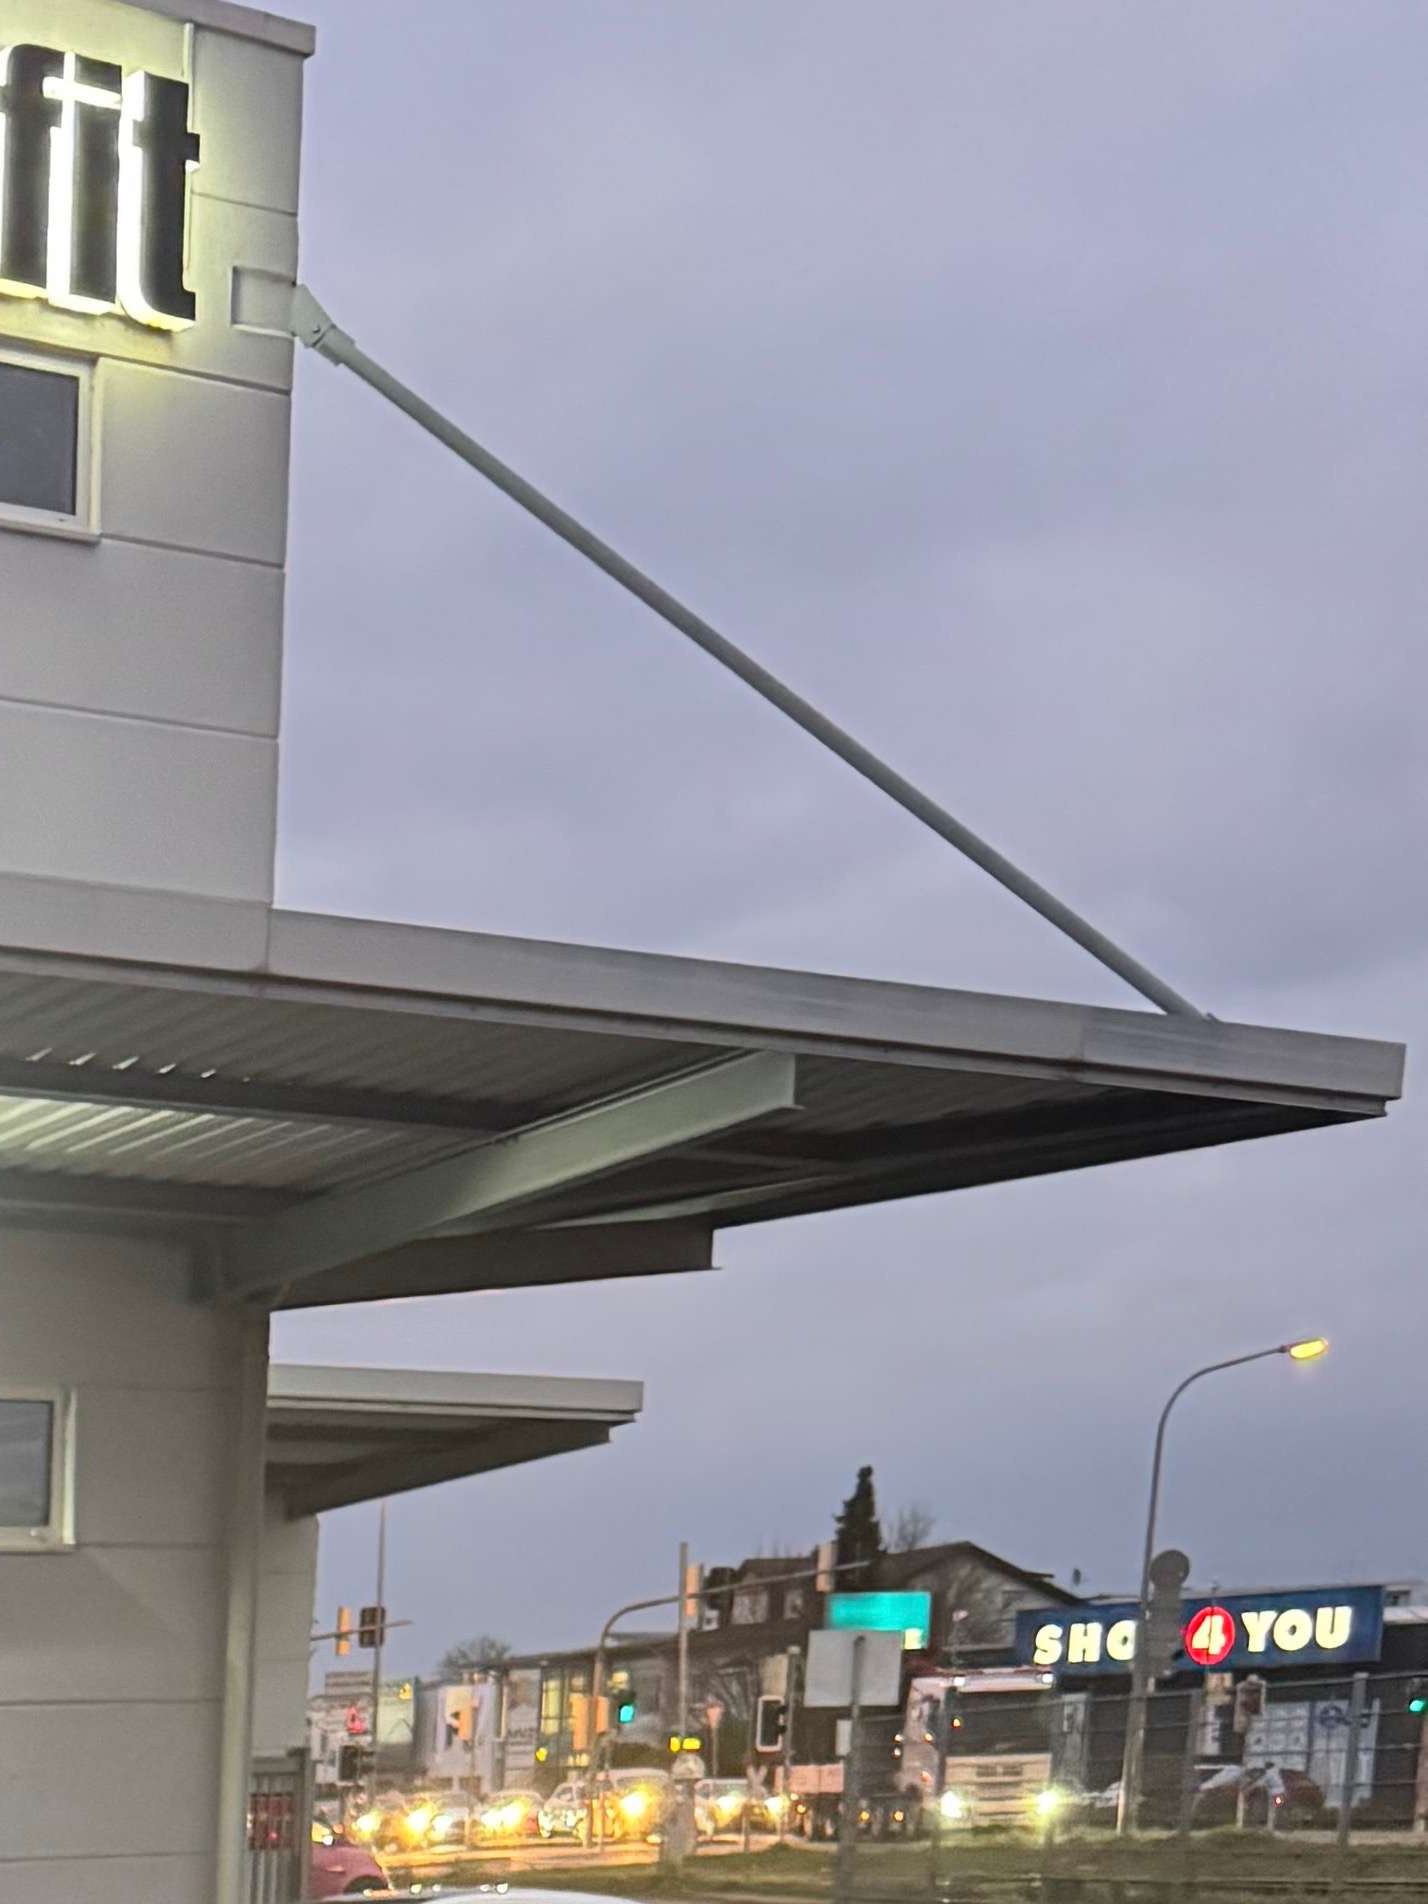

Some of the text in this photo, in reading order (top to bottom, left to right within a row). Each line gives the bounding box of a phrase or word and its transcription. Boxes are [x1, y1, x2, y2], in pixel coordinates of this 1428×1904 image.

[1033, 1606, 1352, 1666] SHO 4 YOU
